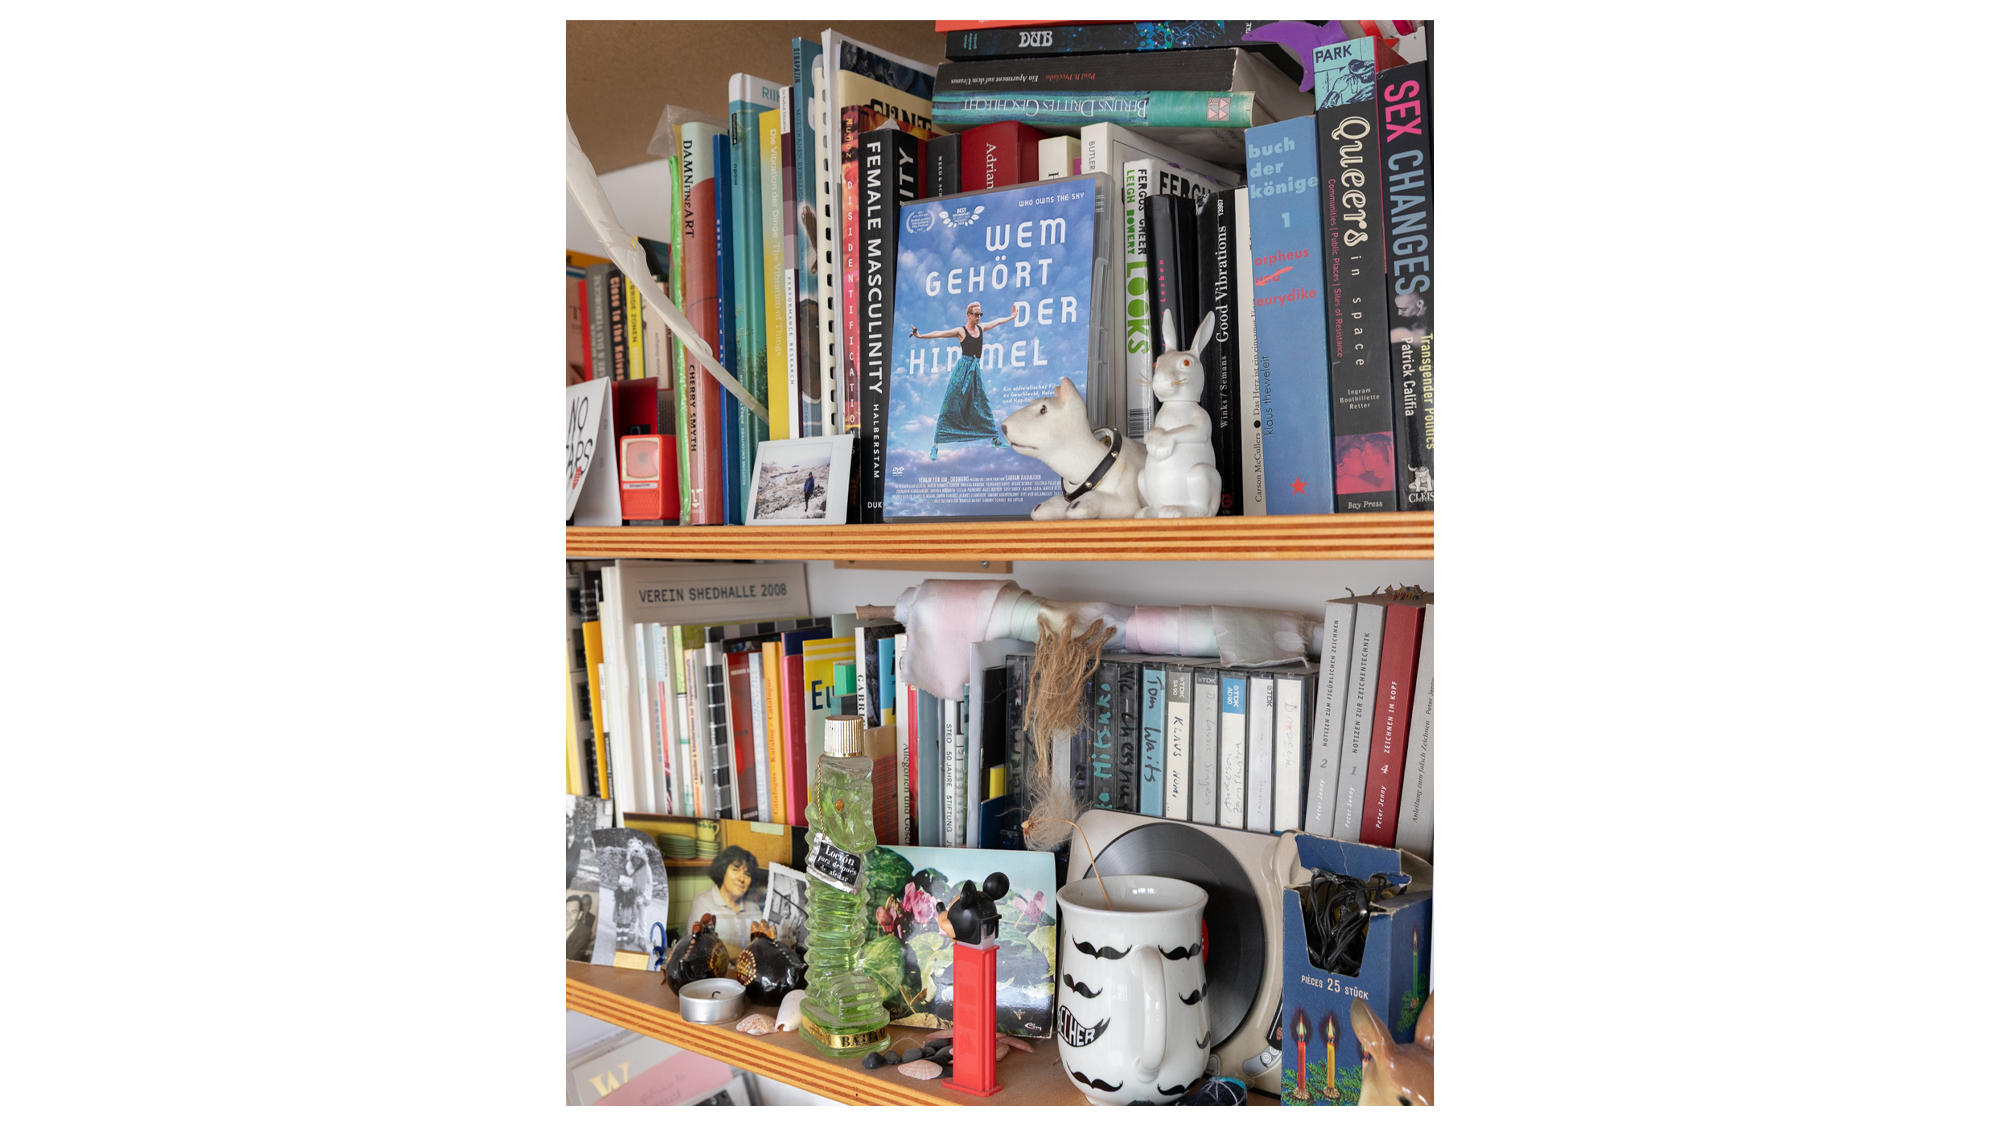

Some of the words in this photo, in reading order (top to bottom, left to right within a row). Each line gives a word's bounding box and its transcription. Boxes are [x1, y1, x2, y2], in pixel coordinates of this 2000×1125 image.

[1315, 44, 1352, 63] PARK
[985, 76, 995, 84] auf
[996, 74, 1028, 83] Apartment
[961, 99, 1040, 117] GESCHLECHT
[1043, 99, 1095, 117] DRITTES
[1098, 99, 1148, 118] BERLINS
[1384, 80, 1422, 143] SEX
[769, 128, 777, 145] Die
[1248, 136, 1296, 159] buch
[770, 145, 779, 190] Vibration
[986, 142, 997, 190] Adrian
[1088, 141, 1096, 171] BUTLER
[1250, 162, 1284, 178] der
[866, 141, 882, 231] FEMALE
[1126, 169, 1136, 204] LEIGH
[1138, 169, 1148, 212] FERGUS
[1250, 176, 1319, 200] könige
[1331, 115, 1371, 247] Queers
[771, 191, 779, 208] der
[1018, 199, 1033, 207] WHO
[1035, 196, 1054, 205] OWNS
[1057, 194, 1069, 202] THE
[1071, 192, 1085, 200] SKY
[1328, 179, 1337, 226] Communities
[771, 209, 780, 239] Dinge
[985, 217, 1066, 252] WEM
[1126, 209, 1136, 255] BOWERY
[1281, 212, 1291, 228] 1
[1388, 149, 1431, 295] CHANGES
[1138, 218, 1147, 255] GREER
[1331, 232, 1339, 255] Public
[1215, 225, 1228, 302] Vibrations
[1254, 249, 1309, 267] orpheus
[1332, 257, 1340, 282] Places
[1351, 255, 1362, 276] in
[773, 262, 781, 310] Vibration
[925, 254, 1053, 297] GEHÖRT
[1255, 269, 1281, 285] und
[610, 276, 621, 308] Close
[1256, 287, 1317, 307] eurydike
[1333, 288, 1342, 307] Sites
[612, 310, 622, 322] to
[775, 312, 781, 322] of
[867, 238, 883, 395] MASCULINITY
[1013, 296, 1078, 328] DER
[1126, 261, 1150, 355] LOOKS
[1335, 308, 1343, 316] of
[613, 323, 623, 343] the
[630, 313, 638, 343] ZONEN
[1215, 305, 1229, 343] Good
[1335, 318, 1343, 358] Resistance
[1351, 297, 1365, 366] space
[775, 322, 783, 357] Things
[614, 345, 625, 382] Knives
[1401, 336, 1415, 378] Patrick
[1419, 333, 1434, 404] Transgender
[688, 364, 697, 408] CHERRY
[1219, 355, 1227, 391] Semans
[1260, 355, 1273, 405] theweleit
[1340, 394, 1380, 403] Bouthillette
[1347, 388, 1371, 396] Ingram
[1403, 380, 1417, 417] Califia
[568, 396, 589, 434] NO
[1220, 403, 1228, 429] Winks
[1264, 407, 1274, 437] klaus
[1424, 408, 1434, 450] Politics
[689, 413, 697, 452] SMYTH
[1253, 432, 1261, 473] McCullers
[1254, 474, 1262, 503] Carson
[867, 501, 882, 509] DUK
[1348, 501, 1361, 510] Bay
[1363, 500, 1383, 508] Press
[639, 588, 685, 603] VEREIN
[688, 585, 757, 601] SHEDHALLE
[760, 583, 787, 597] 2008
[1357, 632, 1370, 700] ZEICHENTECHNIK
[1146, 676, 1165, 709] Tom
[1322, 718, 1330, 747] NOTIZEN
[1326, 655, 1336, 700] FIGÜRLICHEN
[1331, 619, 1339, 653] ZEICHNEN
[1389, 680, 1398, 701] KOPF
[765, 677, 773, 720] Catalogue
[1355, 703, 1363, 718] ZUR
[1388, 703, 1395, 713] IM
[1425, 698, 1433, 715] Peter
[768, 728, 776, 763] Katalog
[945, 723, 953, 744] STEO
[1352, 721, 1361, 754] NOTIZEN
[1383, 716, 1394, 754] ZEICHNEN
[1420, 720, 1430, 751] Zeichnen
[946, 751, 953, 761] 50
[1143, 726, 1162, 783] Waits
[1319, 758, 1328, 769] 2
[1417, 752, 1426, 774] falsch
[771, 771, 779, 815] Catalogus
[1317, 778, 1326, 800] Jenny
[1346, 786, 1355, 807] Jenny
[1378, 785, 1387, 807] Jenny
[903, 796, 911, 815] und
[1315, 801, 1323, 821] Peter
[1344, 808, 1352, 829] Peter
[1375, 808, 1384, 829] Peter
[1412, 790, 1422, 823] Anleitung
[825, 844, 855, 866] Loción
[1301, 973, 1324, 989] PIÈCES
[1326, 978, 1340, 993] 25
[1344, 986, 1369, 1001] STÜCK
